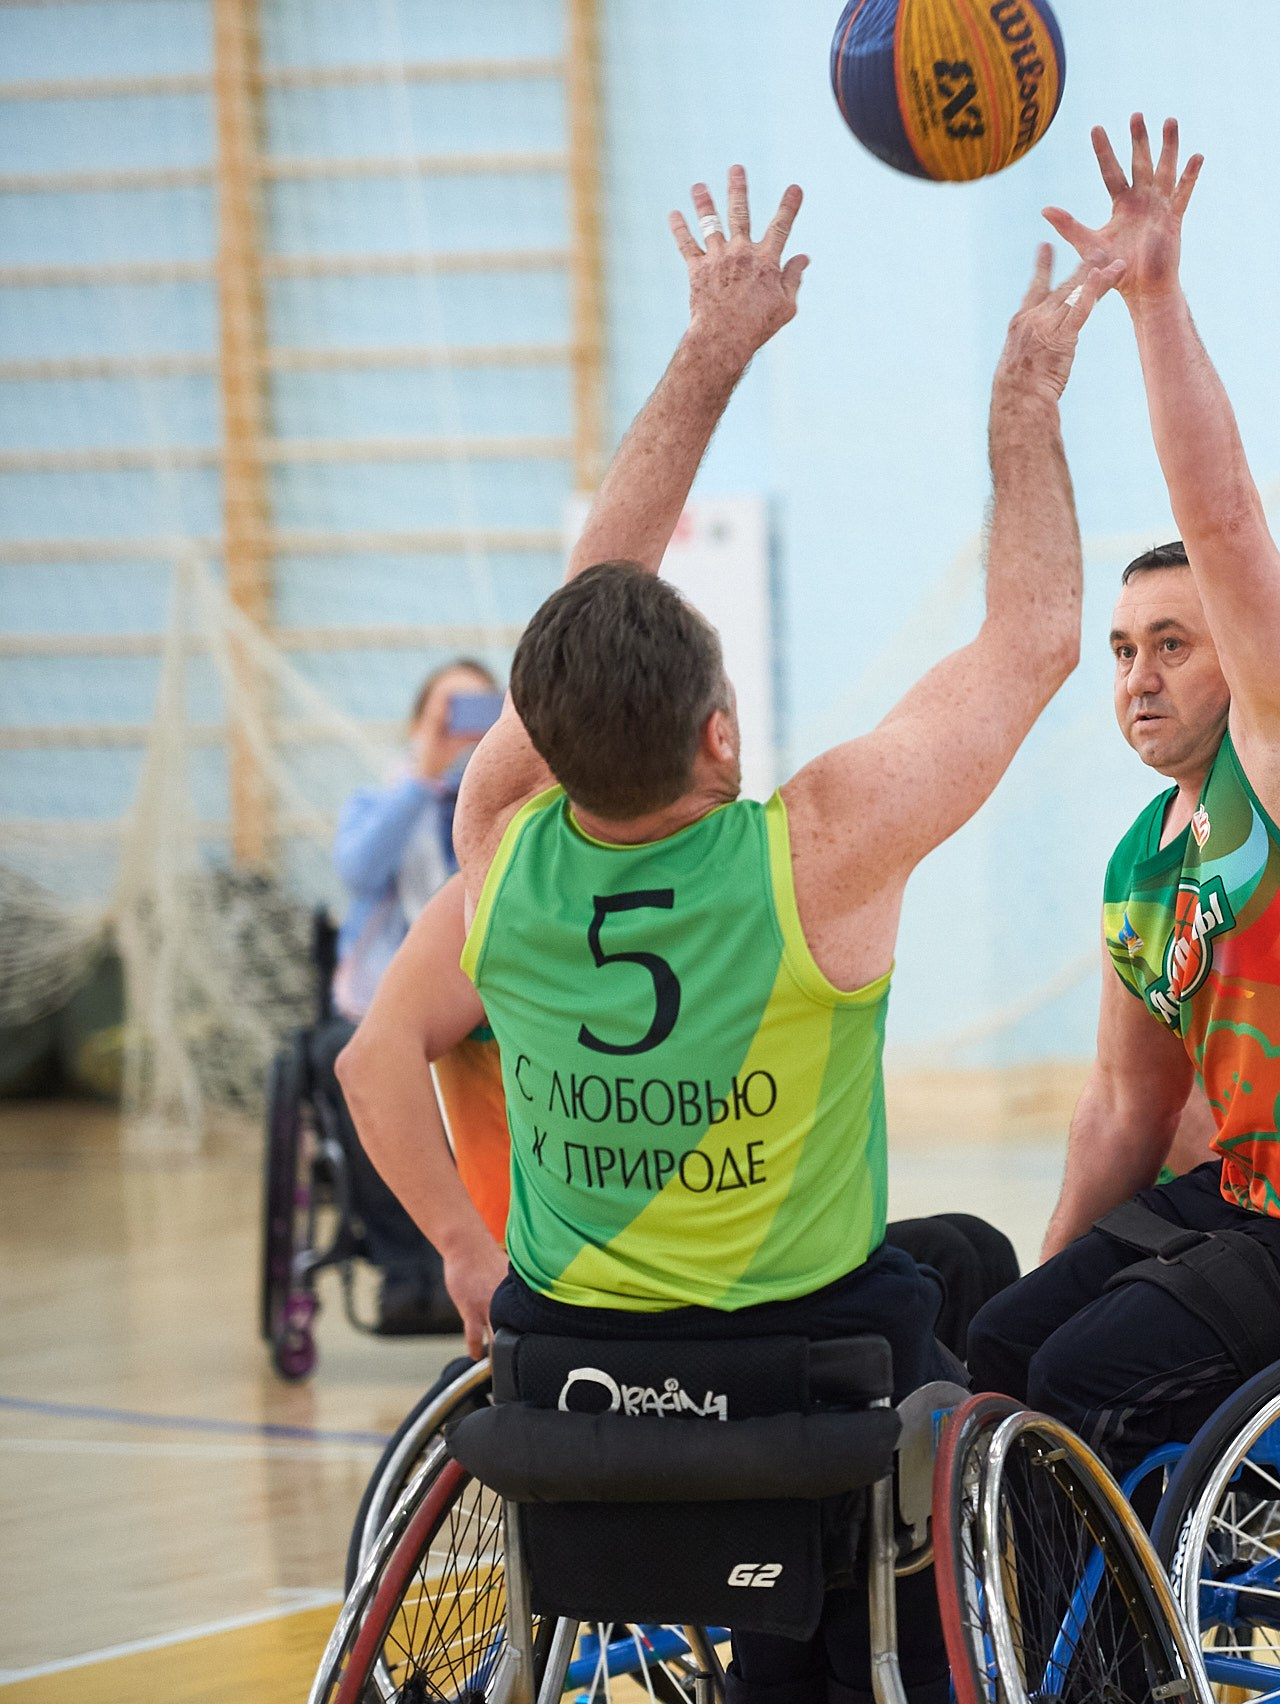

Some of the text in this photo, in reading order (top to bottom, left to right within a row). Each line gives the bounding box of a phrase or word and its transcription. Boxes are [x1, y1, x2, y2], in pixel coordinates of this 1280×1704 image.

[577, 889, 682, 1056] 5
[515, 1054, 778, 1127] С ЛЮБОВЬЮ
[563, 1140, 768, 1195] ПРИРОДЕ
[727, 1563, 784, 1588] G2
